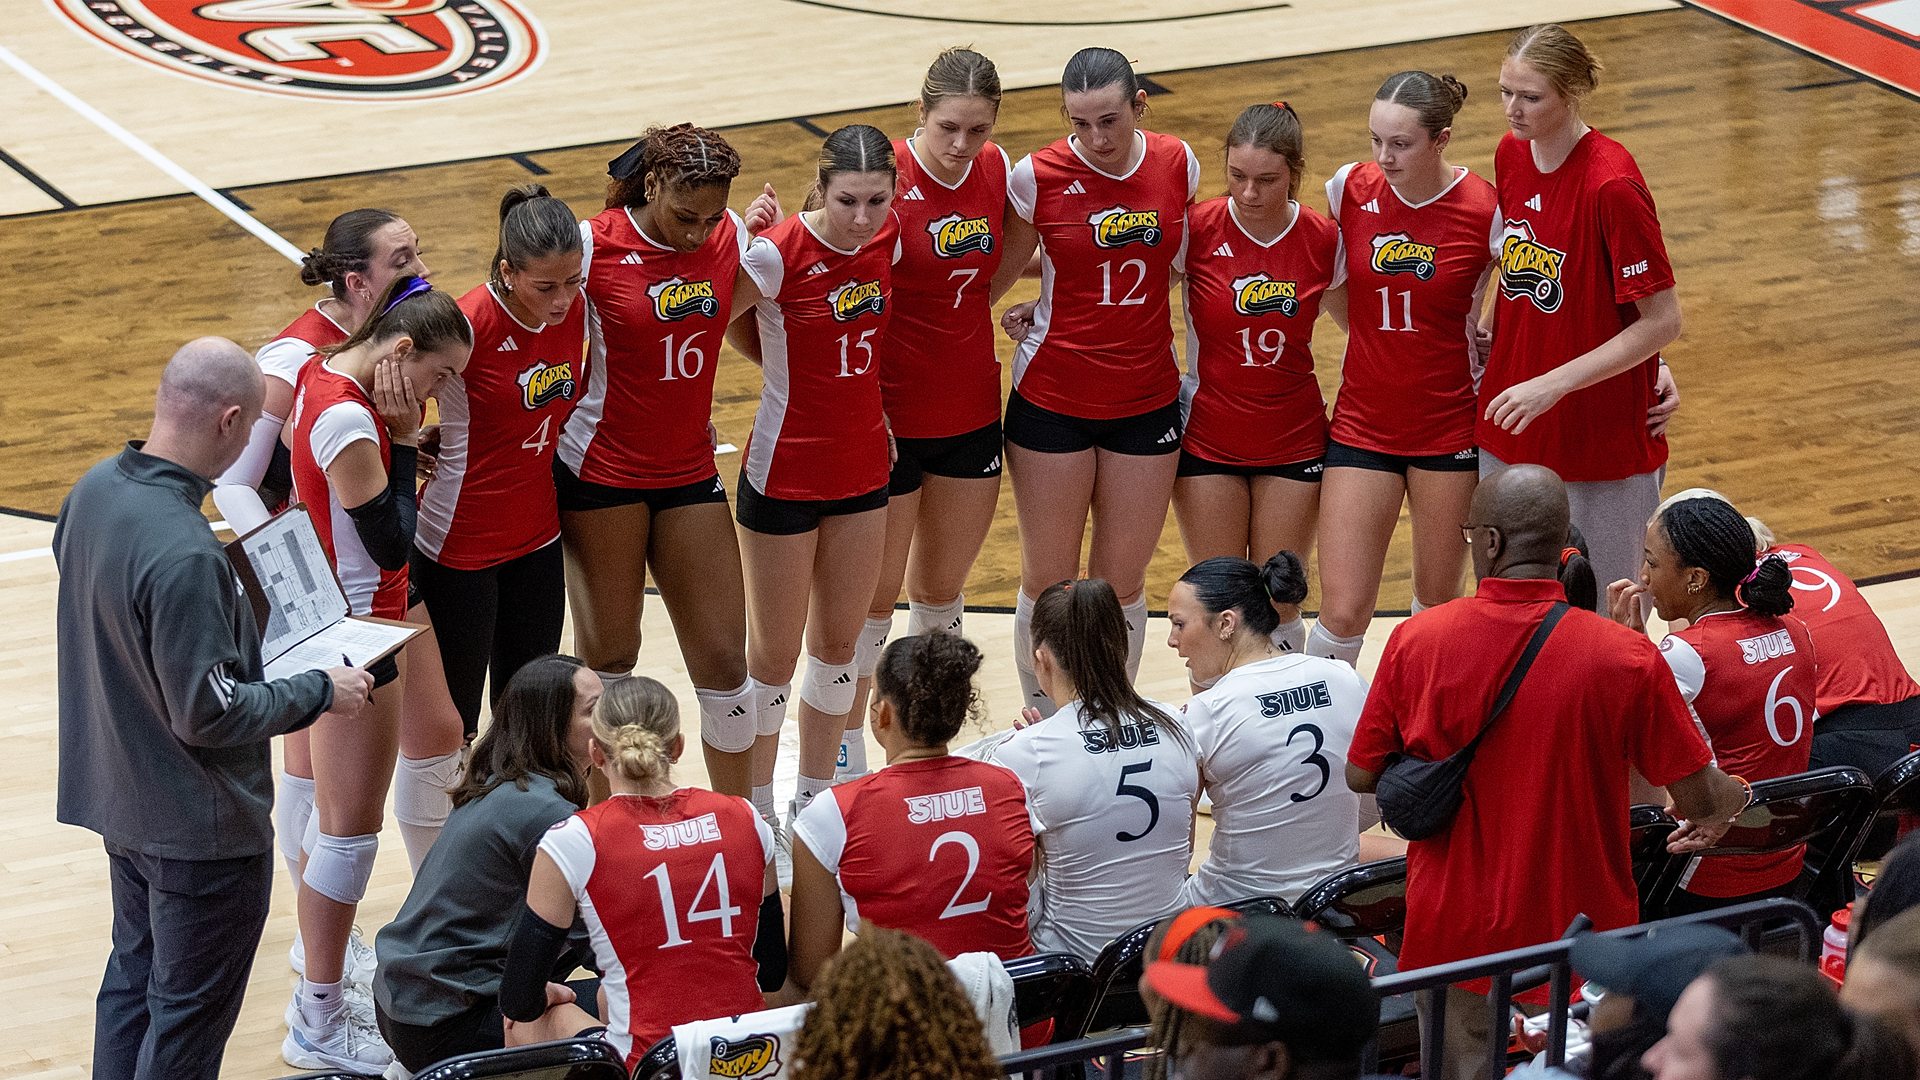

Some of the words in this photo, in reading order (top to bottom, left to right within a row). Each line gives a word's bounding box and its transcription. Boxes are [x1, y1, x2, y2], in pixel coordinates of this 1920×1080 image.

[451, 4, 505, 82] VALLEY
[938, 217, 990, 253] 66ERS
[1100, 211, 1158, 244] 66ERS
[1376, 240, 1436, 268] 66ERS
[1501, 237, 1560, 280] 66ERS
[1621, 260, 1649, 278] SIUE
[659, 281, 713, 316] 66ERS
[837, 280, 881, 316] 66ERS
[947, 268, 980, 309] 7
[1096, 258, 1148, 306] 12
[1240, 280, 1296, 310] 66ERS
[1375, 286, 1419, 332] 11
[658, 330, 707, 381] 16
[835, 327, 879, 378] 15
[1235, 327, 1286, 367] 19
[528, 362, 572, 405] 66ERS
[521, 414, 553, 457] 4
[1787, 566, 1842, 612] 9
[1736, 629, 1796, 665] SIUE
[1255, 680, 1332, 718] SIUE
[1764, 665, 1803, 747] 6
[1077, 719, 1160, 754] SIUE
[1286, 723, 1331, 803] 3
[904, 786, 986, 824] SIUE
[1115, 758, 1160, 842] 5
[638, 812, 722, 850] SIUE
[929, 831, 993, 920] 2
[643, 852, 741, 949] 14
